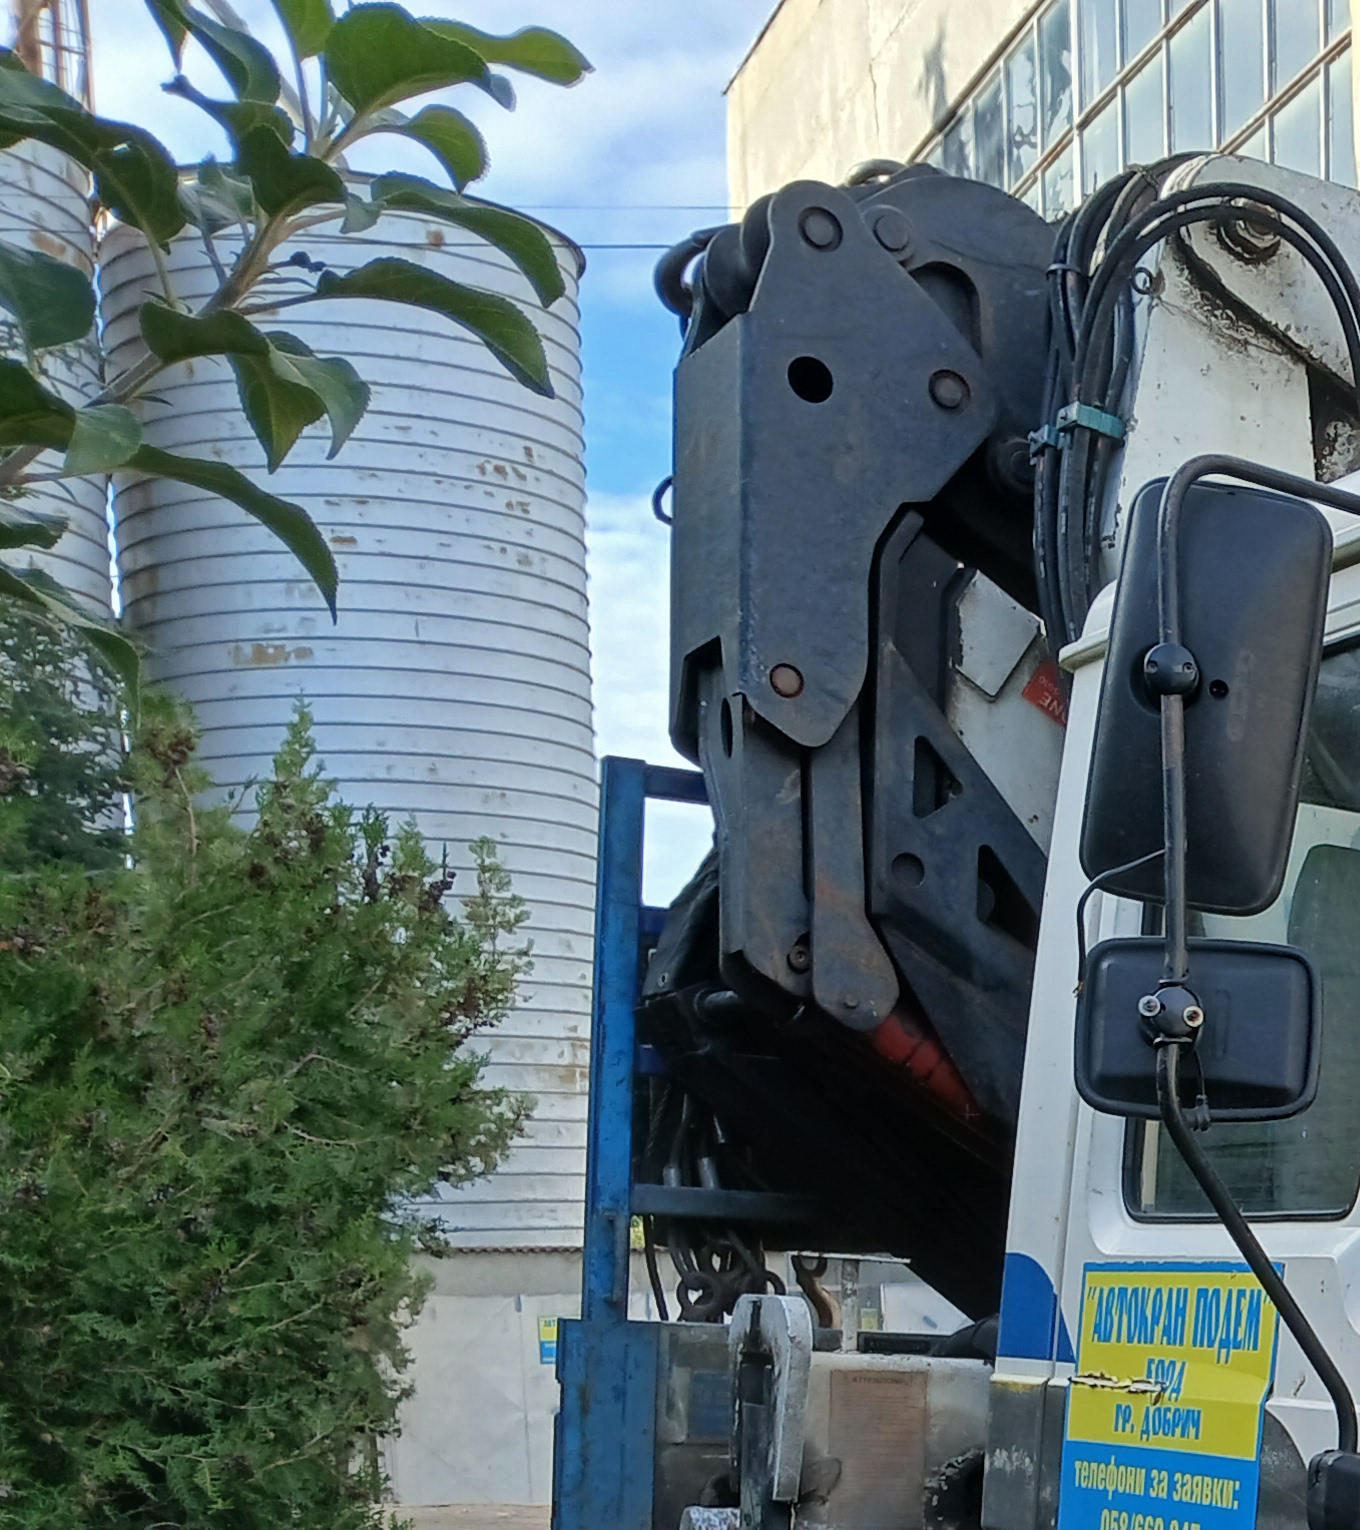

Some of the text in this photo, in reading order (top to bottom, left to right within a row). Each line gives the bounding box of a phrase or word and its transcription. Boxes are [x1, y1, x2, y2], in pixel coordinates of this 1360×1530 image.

[1140, 1406, 1201, 1442] ДОБРИЧ
[1075, 1455, 1240, 1510] телефони за заявки:
